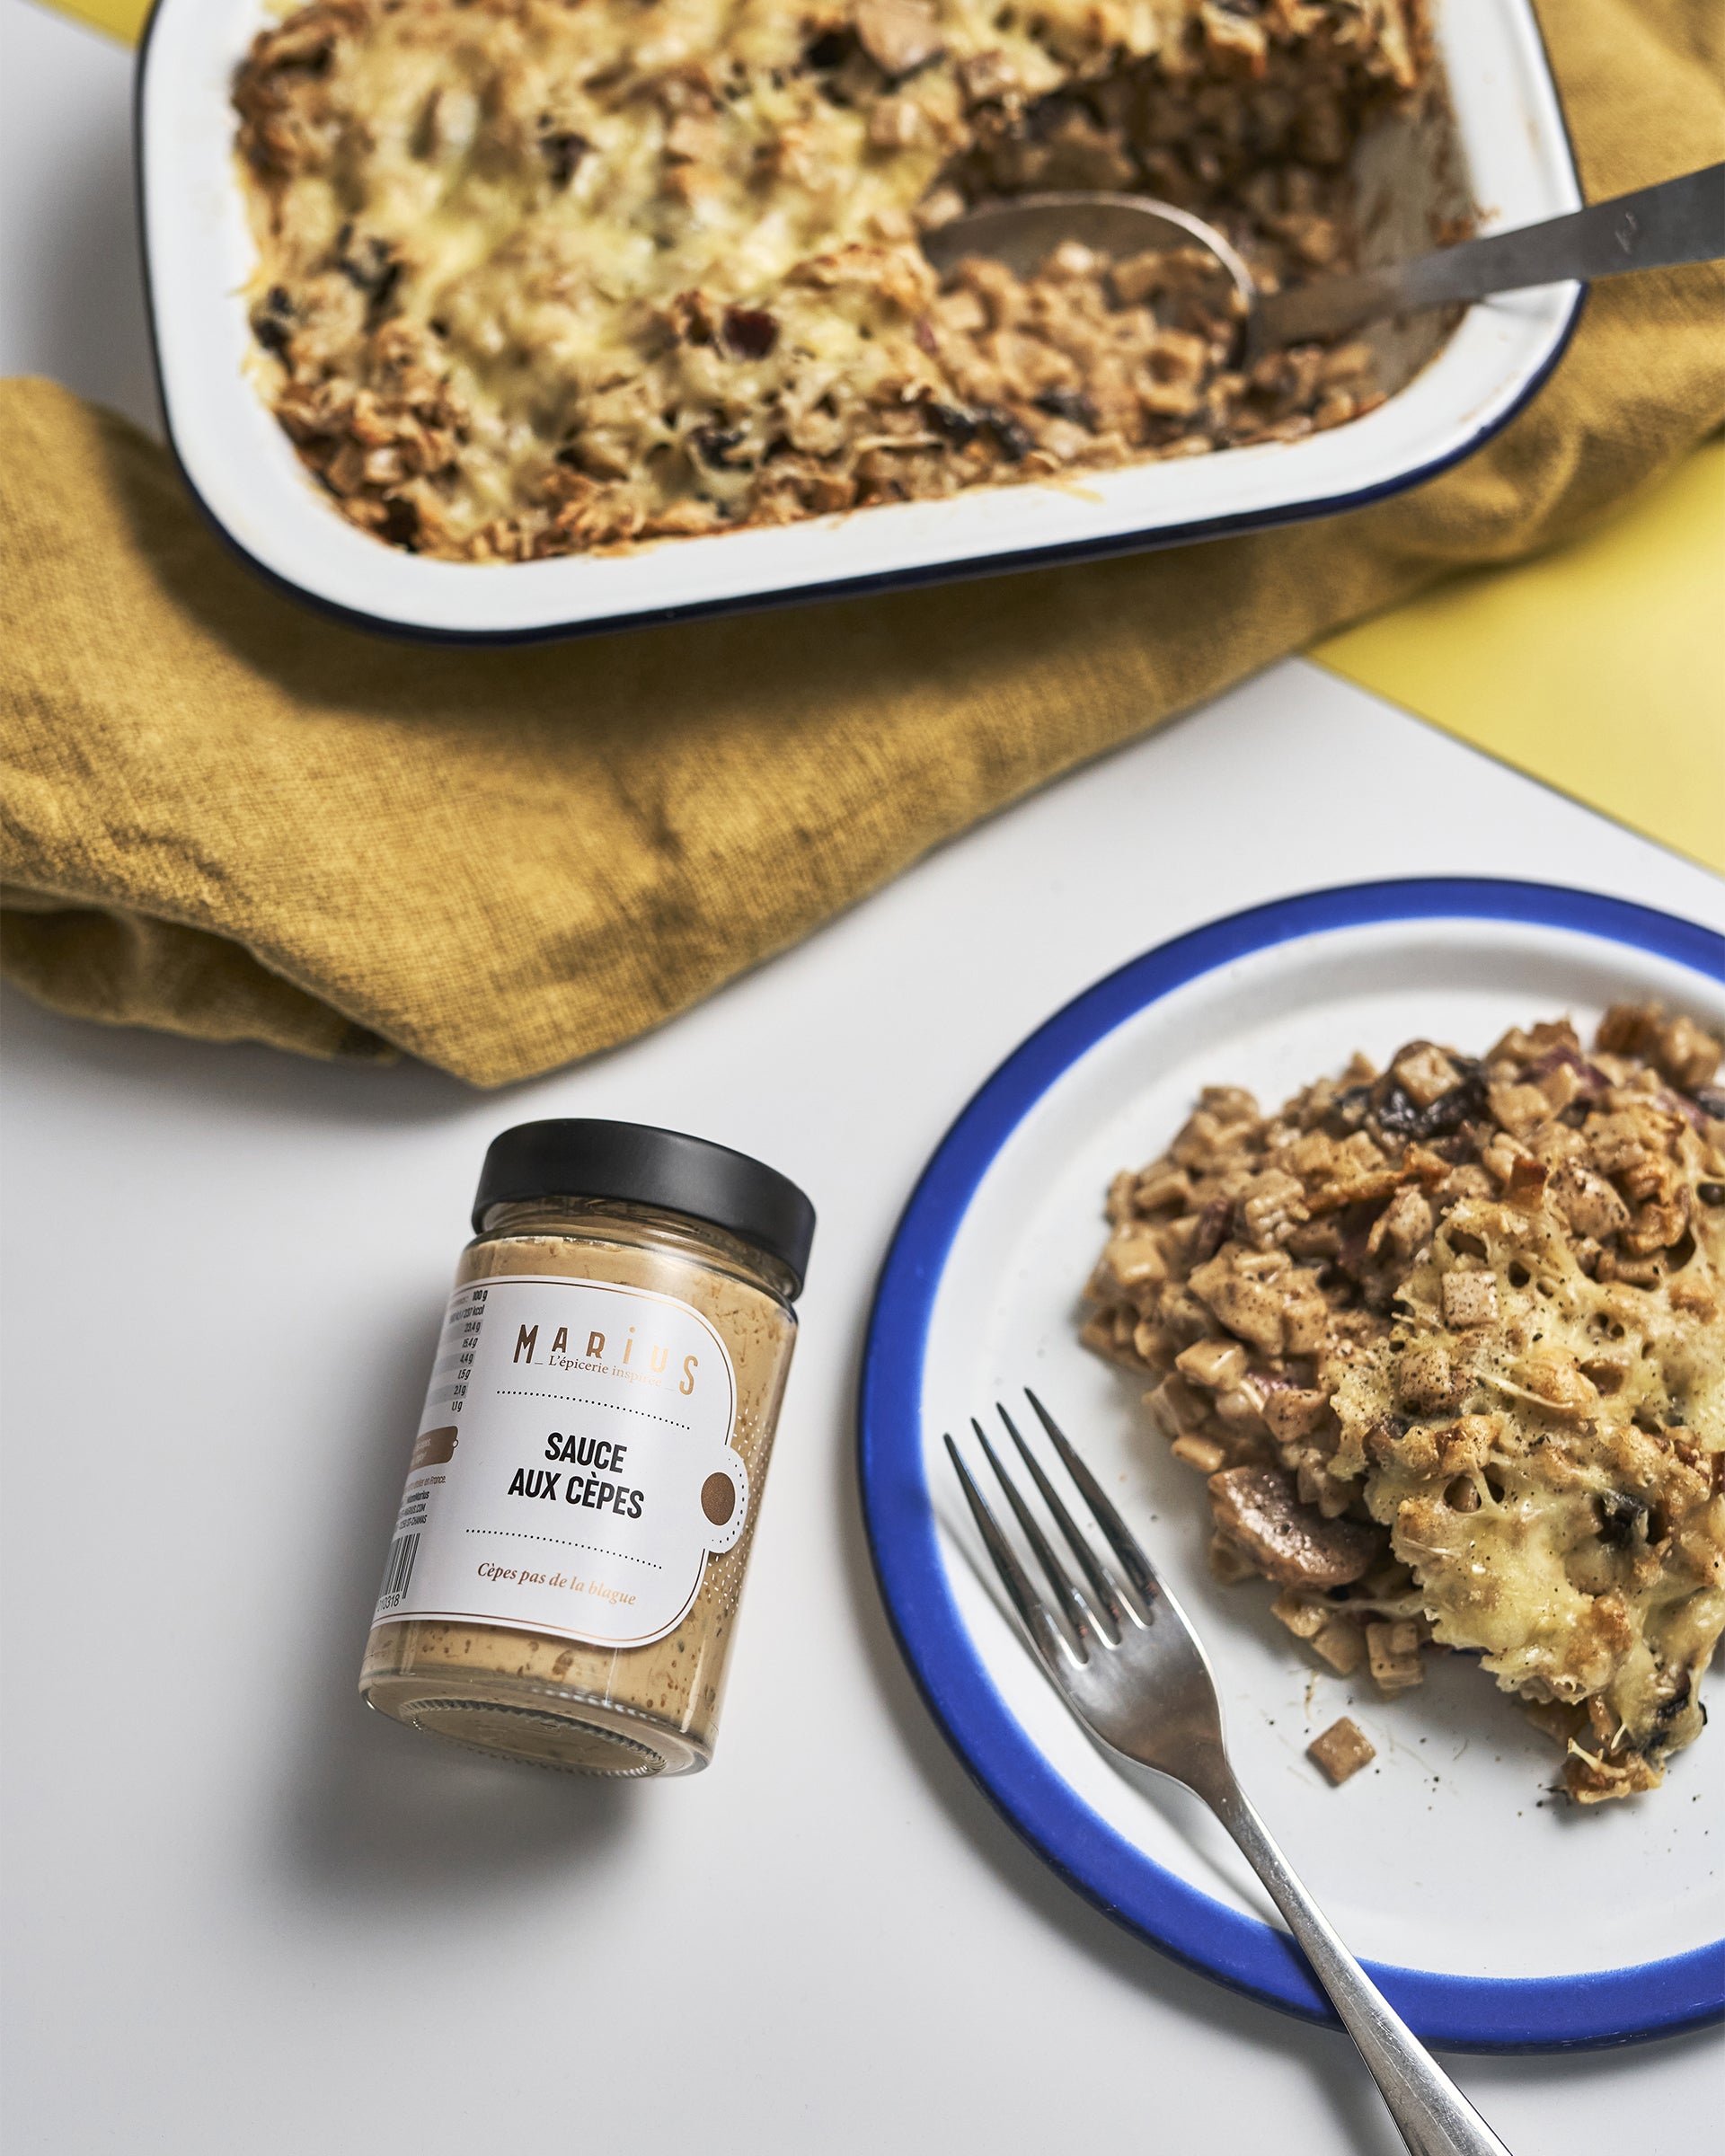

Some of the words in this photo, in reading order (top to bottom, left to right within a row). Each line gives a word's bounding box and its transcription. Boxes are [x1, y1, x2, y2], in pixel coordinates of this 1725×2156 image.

[472, 1290, 482, 1302] 100
[544, 1432, 627, 1473] SAUCE
[508, 1468, 562, 1501] AUX
[565, 1471, 644, 1519] CÈPES
[477, 1562, 518, 1582] Cèpes
[518, 1569, 546, 1585] pas
[549, 1573, 568, 1588] de
[570, 1576, 585, 1593] la
[588, 1580, 636, 1605] blague
